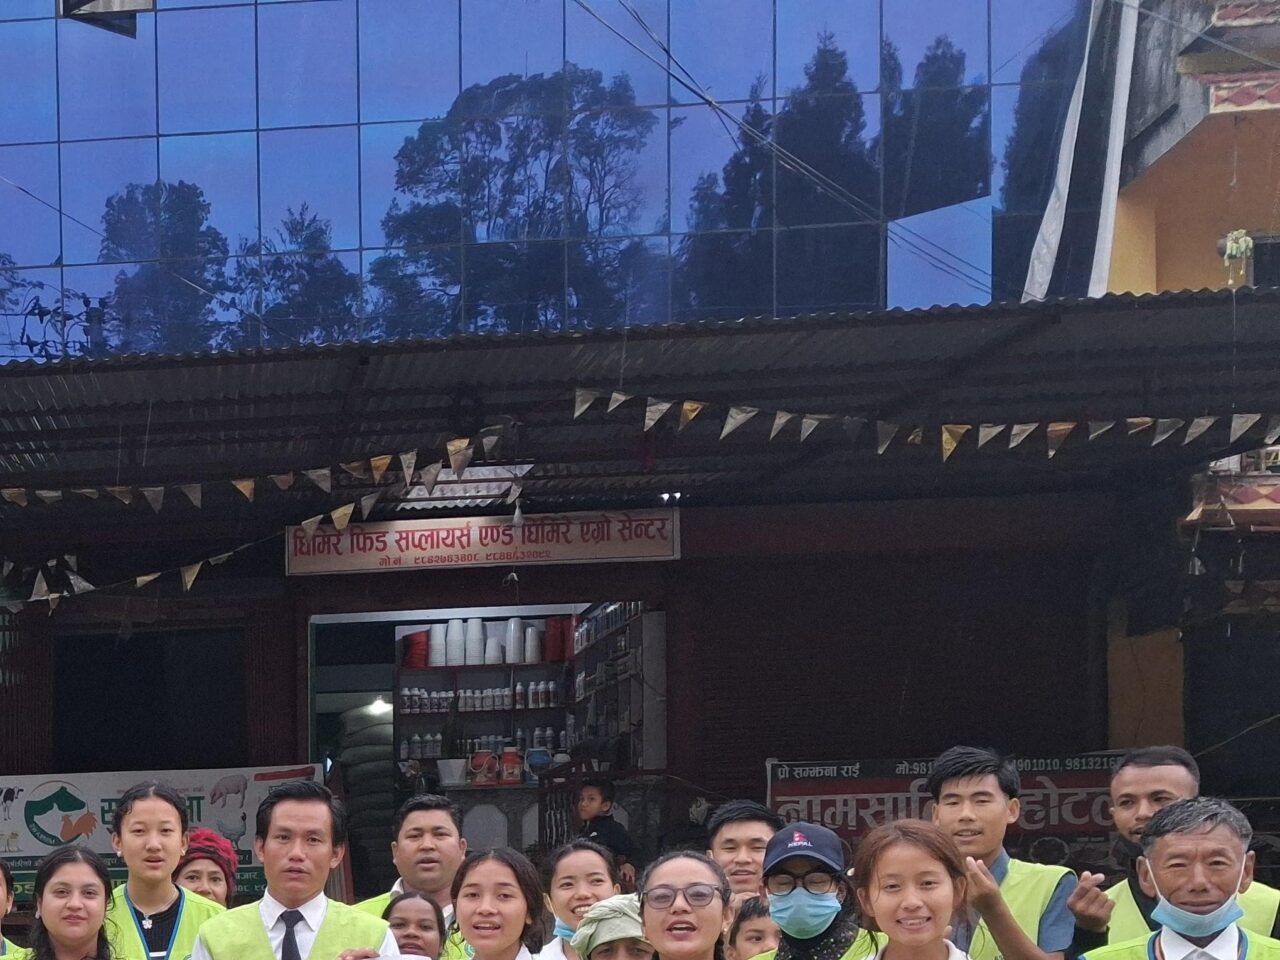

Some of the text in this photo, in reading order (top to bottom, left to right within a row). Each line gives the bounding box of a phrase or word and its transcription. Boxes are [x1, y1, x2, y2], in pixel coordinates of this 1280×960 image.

[350, 525, 389, 554] फिड
[394, 521, 472, 554] सप्लायर्स
[479, 524, 514, 547] एण्ड
[521, 516, 574, 545] घिमिरे
[580, 514, 611, 545] एग्रो
[617, 513, 670, 542] सेन्टर
[840, 762, 860, 778] राई
[1065, 756, 1121, 771] 9813216
[787, 841, 813, 849] NEPAL
